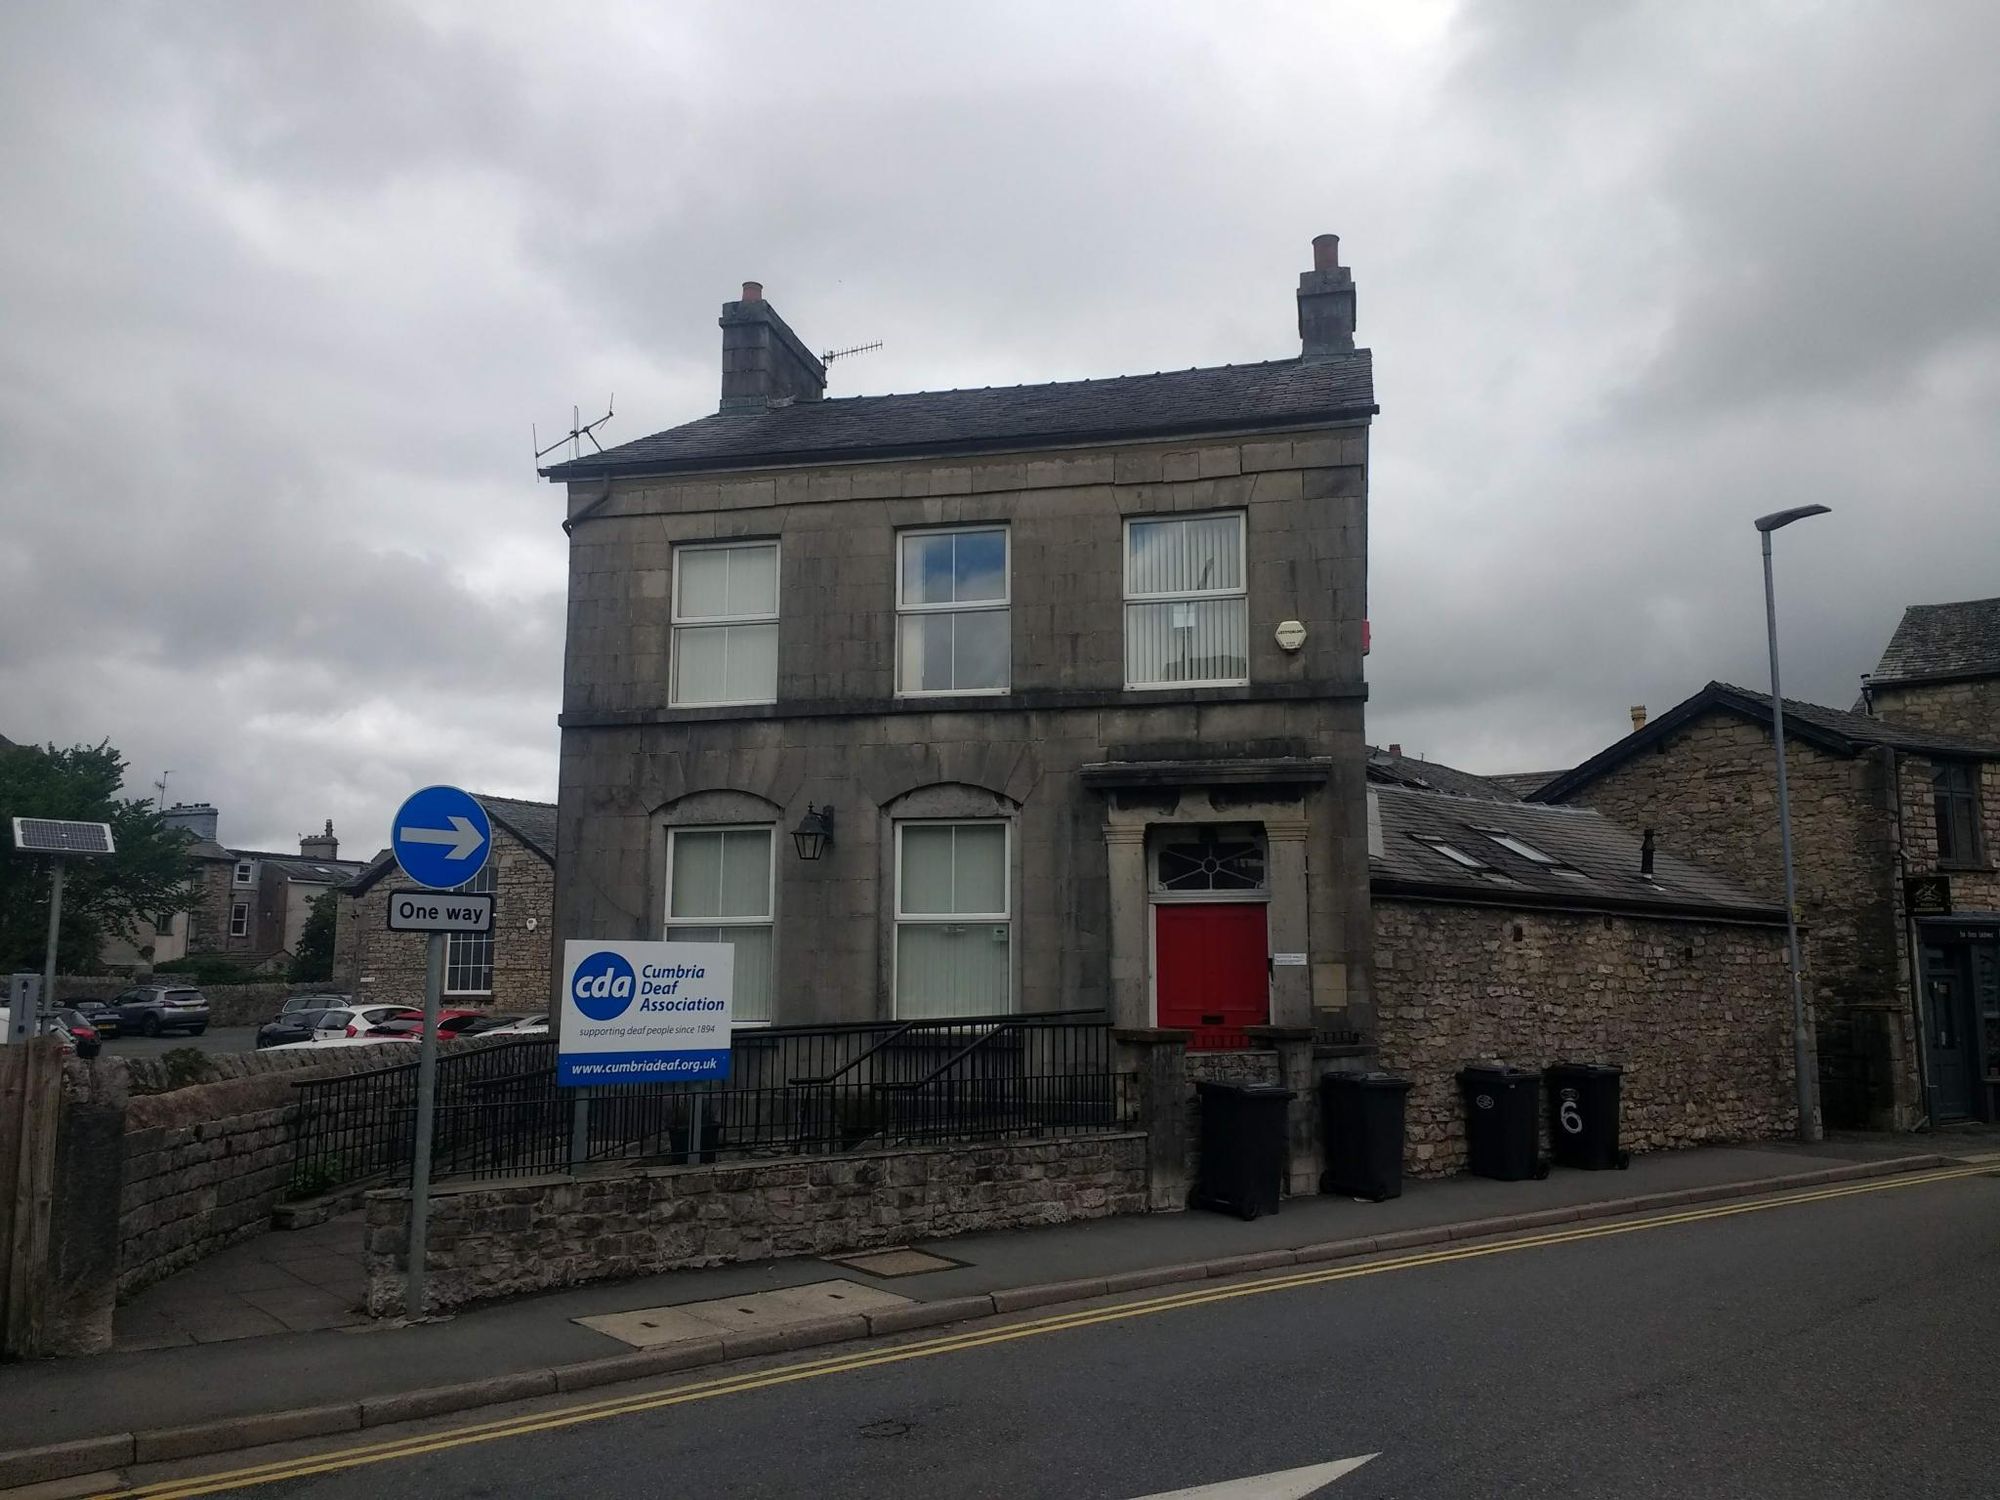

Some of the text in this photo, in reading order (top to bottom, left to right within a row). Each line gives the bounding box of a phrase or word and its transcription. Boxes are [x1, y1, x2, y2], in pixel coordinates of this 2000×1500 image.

[400, 901, 483, 924] One way
[642, 964, 705, 979] Cumbria
[575, 967, 632, 998] cda
[641, 980, 680, 995] Deaf
[640, 997, 725, 1012] Association
[579, 1024, 715, 1037] supporting deaf people since 1894
[572, 1057, 717, 1074] www.cumbriadeaf.org.uk
[1561, 1101, 1583, 1133] 6
